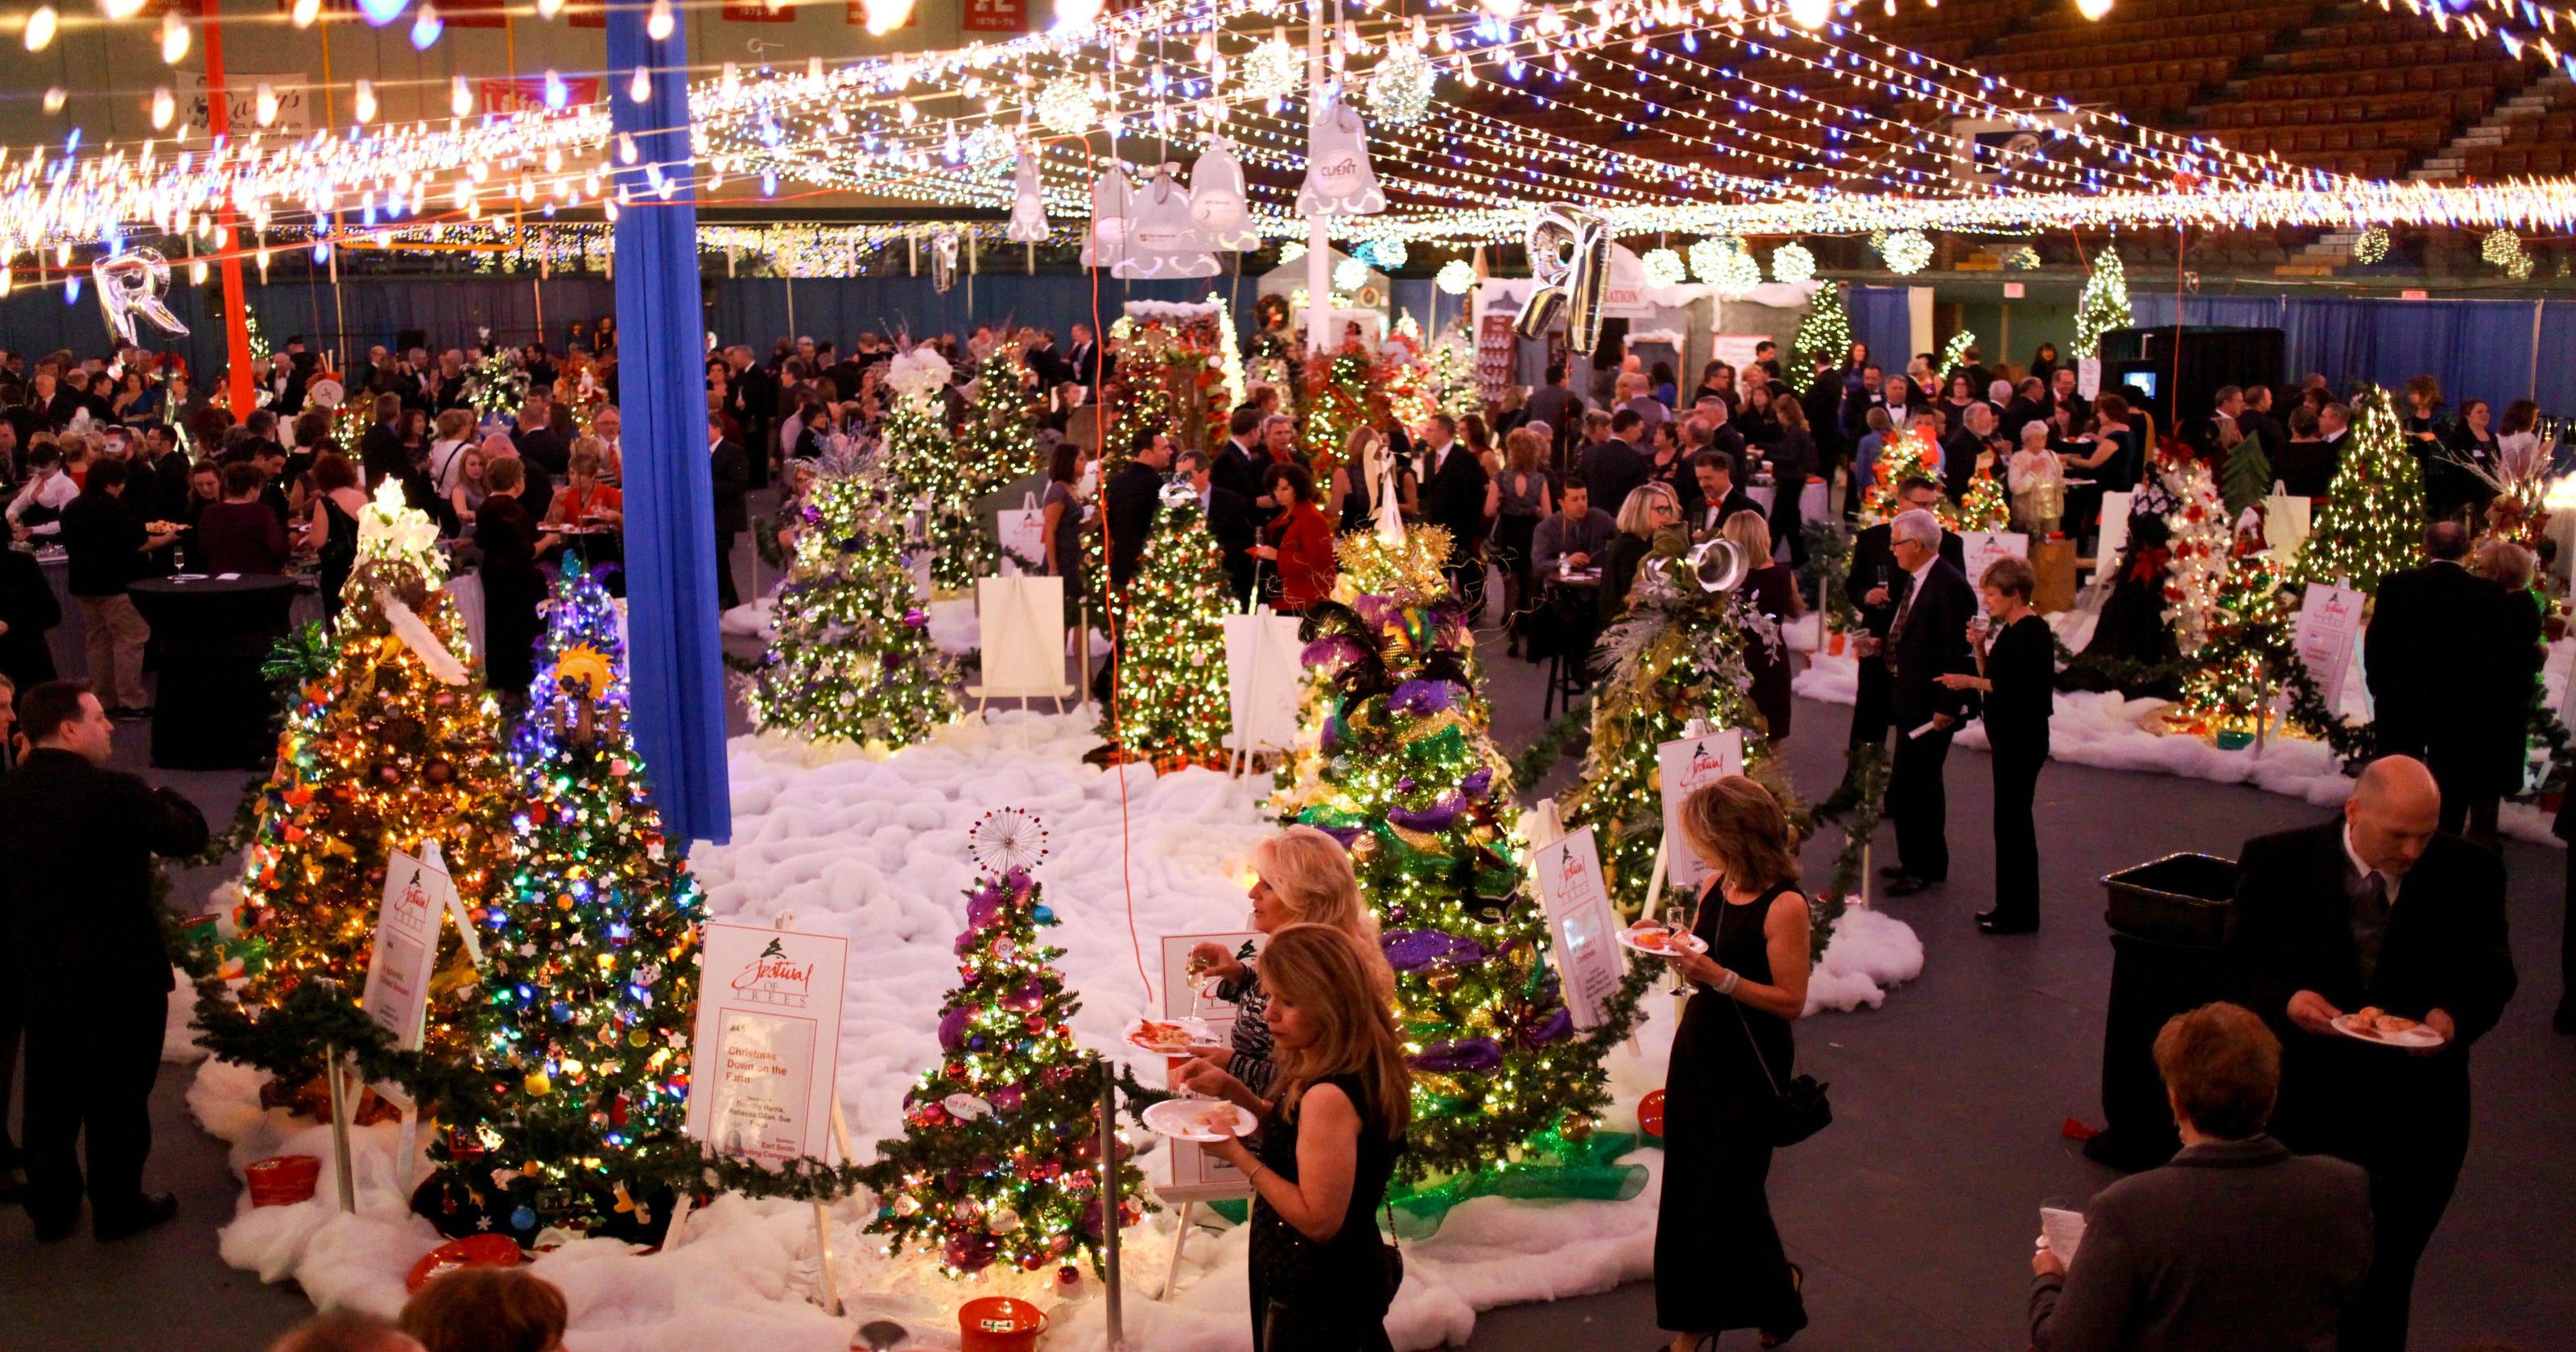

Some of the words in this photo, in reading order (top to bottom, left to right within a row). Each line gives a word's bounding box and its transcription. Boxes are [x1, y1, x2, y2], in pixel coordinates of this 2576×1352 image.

[731, 959, 813, 991] Festival
[764, 982, 778, 991] OF
[734, 989, 806, 1007] TREES
[729, 1046, 777, 1061] Christmas
[727, 1058, 753, 1070] Down
[772, 1066, 787, 1076] the
[776, 1144, 795, 1152] Smith
